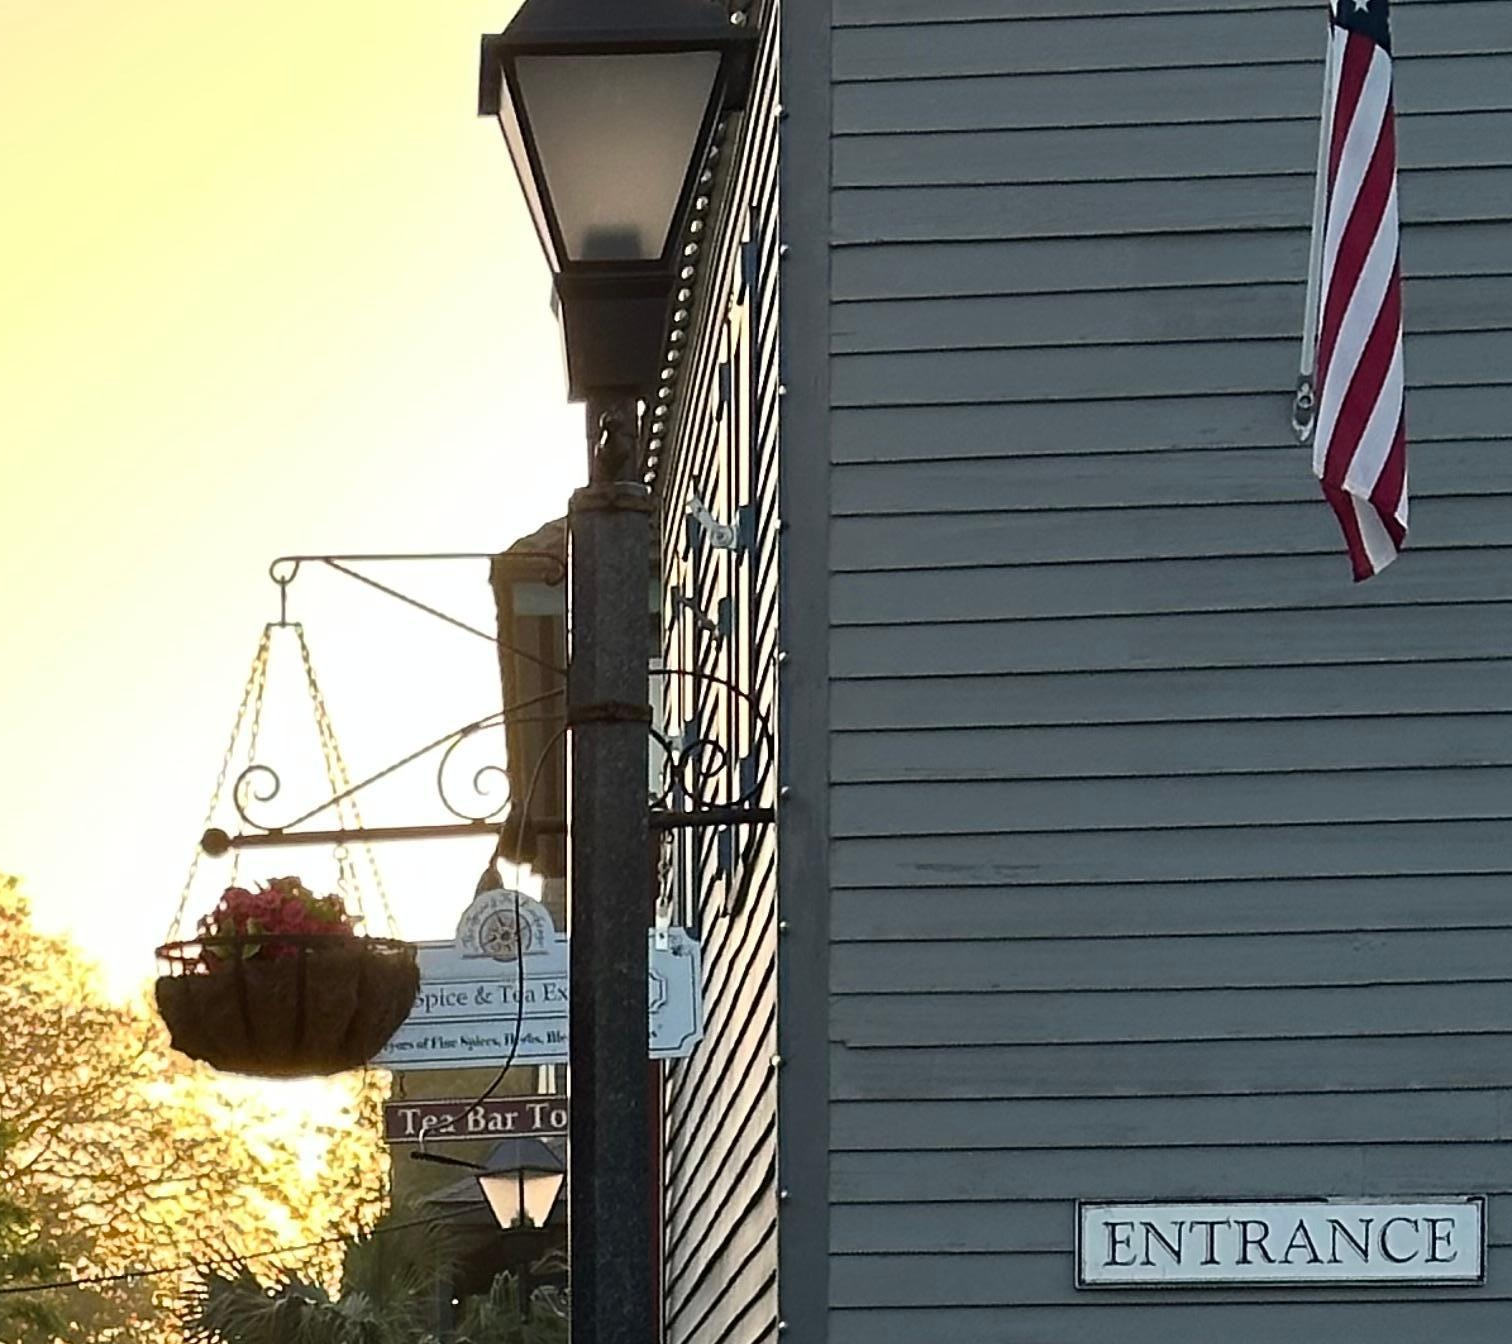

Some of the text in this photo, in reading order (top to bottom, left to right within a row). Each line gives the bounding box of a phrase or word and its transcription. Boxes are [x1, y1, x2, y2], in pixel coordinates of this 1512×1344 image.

[475, 985, 492, 1006] &
[398, 1107, 457, 1136] Tea
[466, 1105, 519, 1132] Bar
[1102, 1216, 1458, 1268] ENTRANCE
